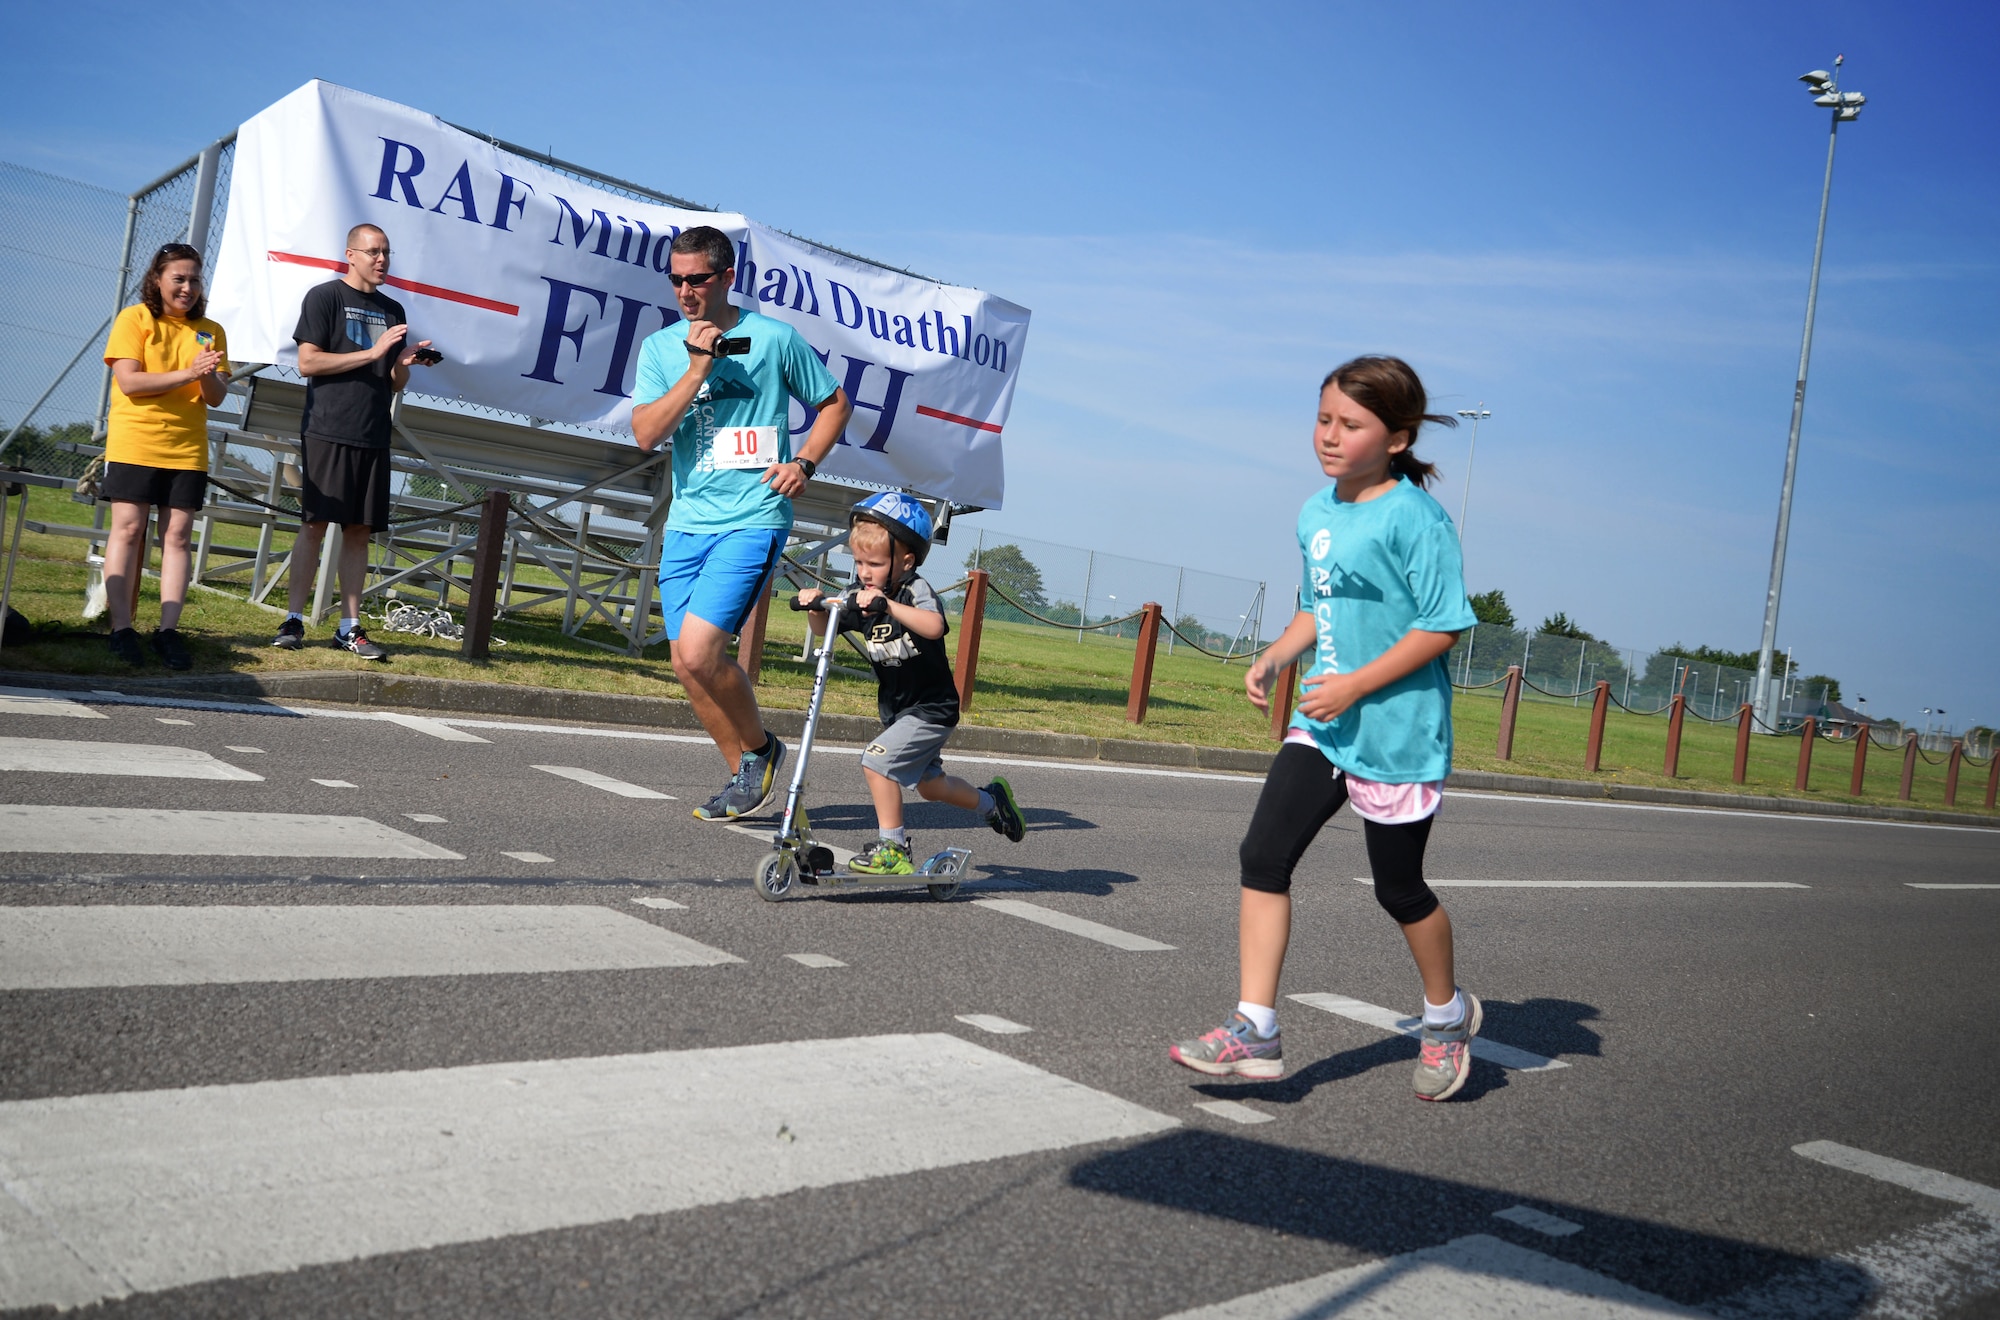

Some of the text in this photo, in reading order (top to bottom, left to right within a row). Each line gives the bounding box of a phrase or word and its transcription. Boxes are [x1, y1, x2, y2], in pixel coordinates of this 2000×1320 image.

[368, 136, 1007, 373] RAF Mildhall Duathlon
[702, 405, 714, 472] CANYON
[734, 430, 758, 455] 10
[871, 624, 893, 643] P
[1317, 567, 1338, 675] AF CANY
[865, 743, 887, 756] P
